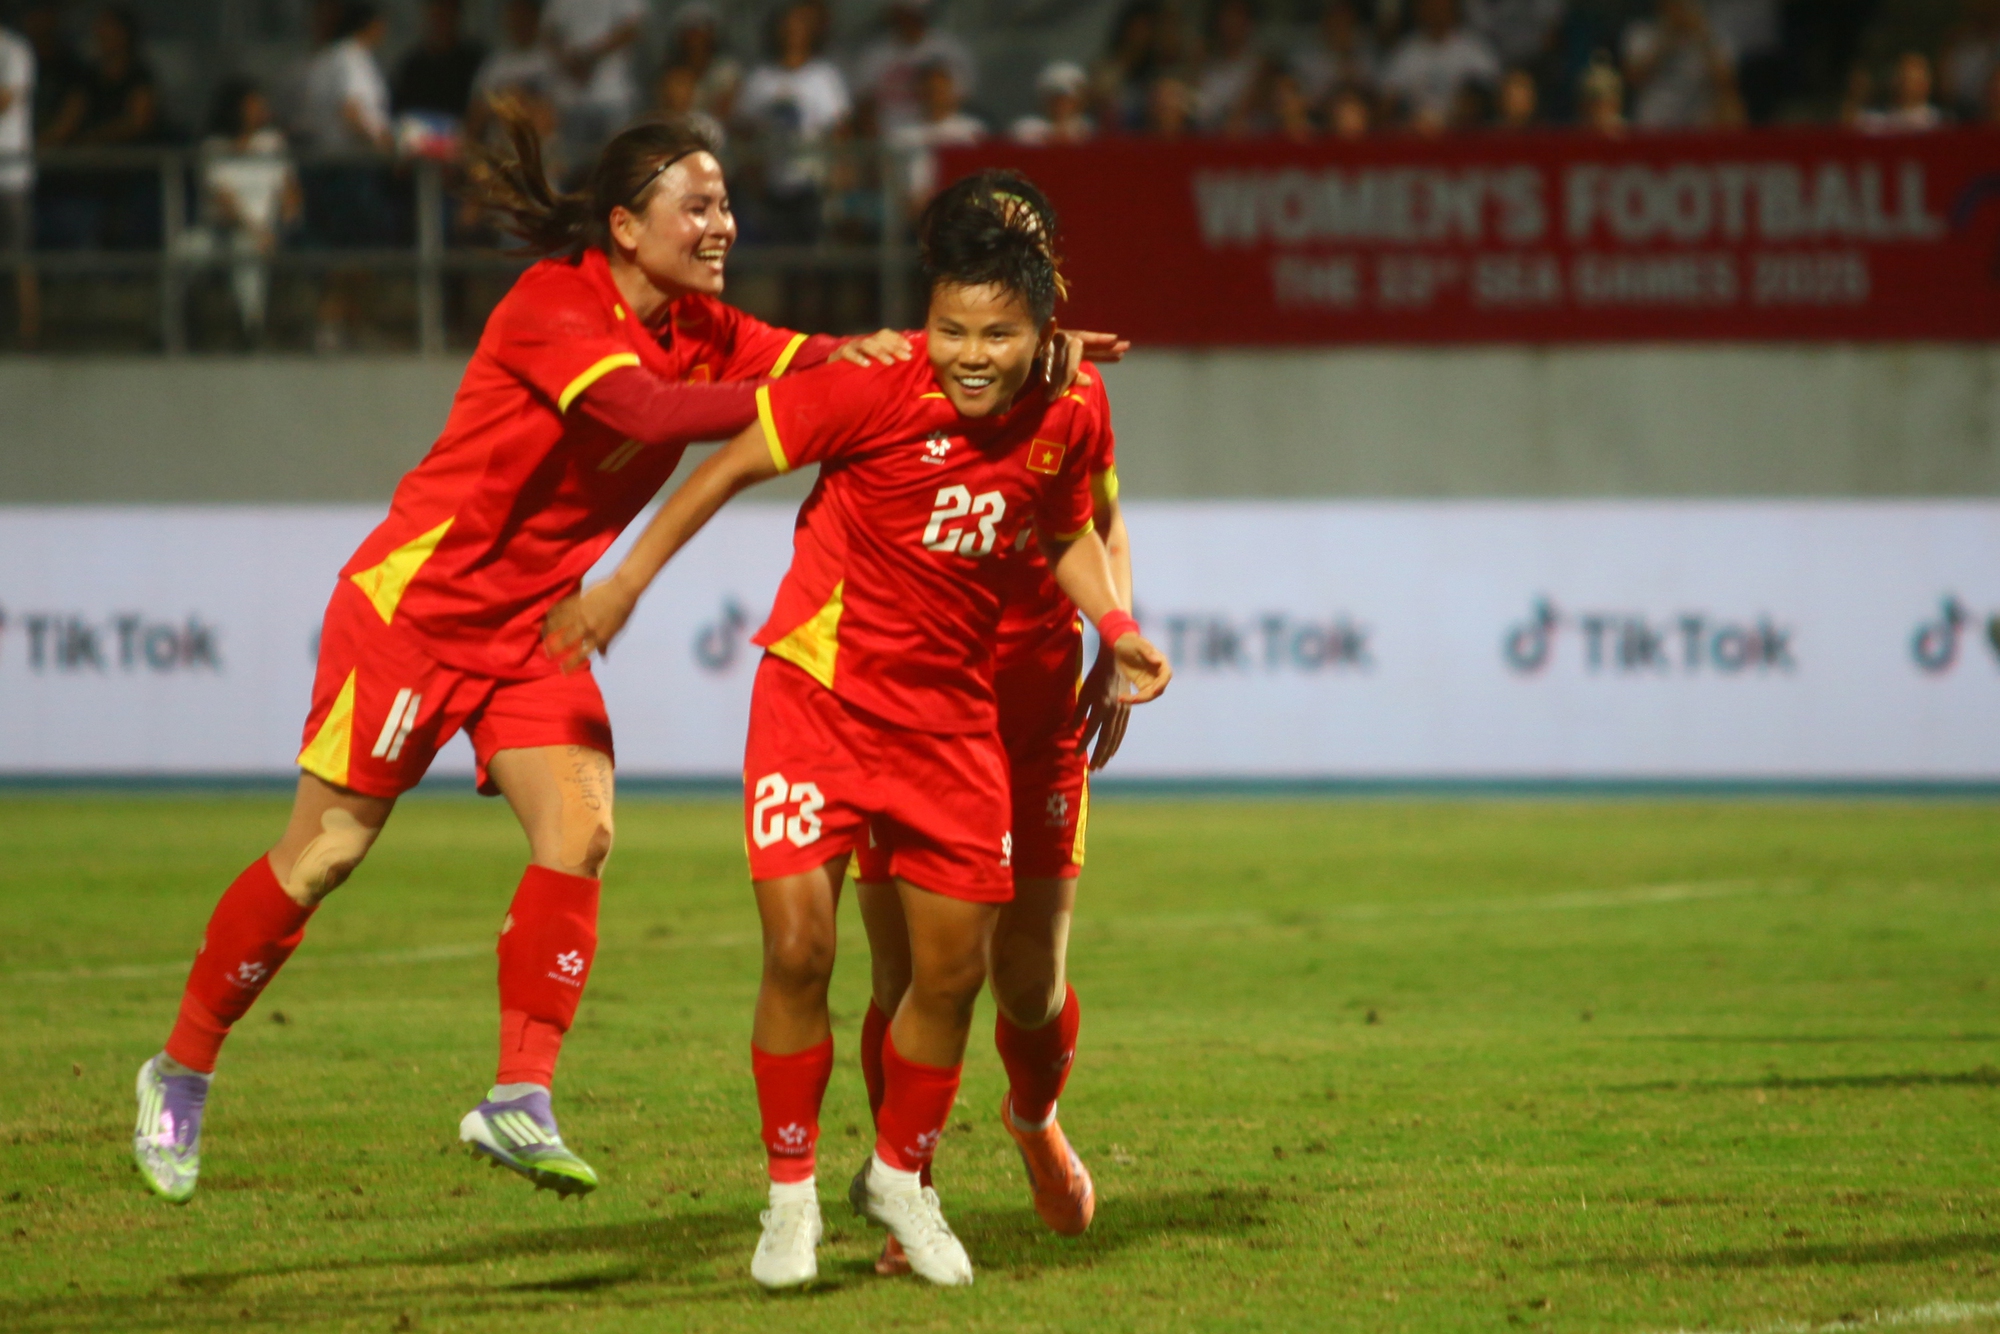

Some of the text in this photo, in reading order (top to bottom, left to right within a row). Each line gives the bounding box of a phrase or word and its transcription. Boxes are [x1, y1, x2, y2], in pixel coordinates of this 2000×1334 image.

[1195, 161, 1945, 246] WOMEN'S FOOTBALL
[922, 484, 1006, 557] 23
[24, 612, 223, 677] TikTok
[1165, 611, 1379, 675] TikTok
[1580, 611, 1797, 677] TikTok
[371, 688, 422, 762] 11
[753, 772, 826, 849] 23
